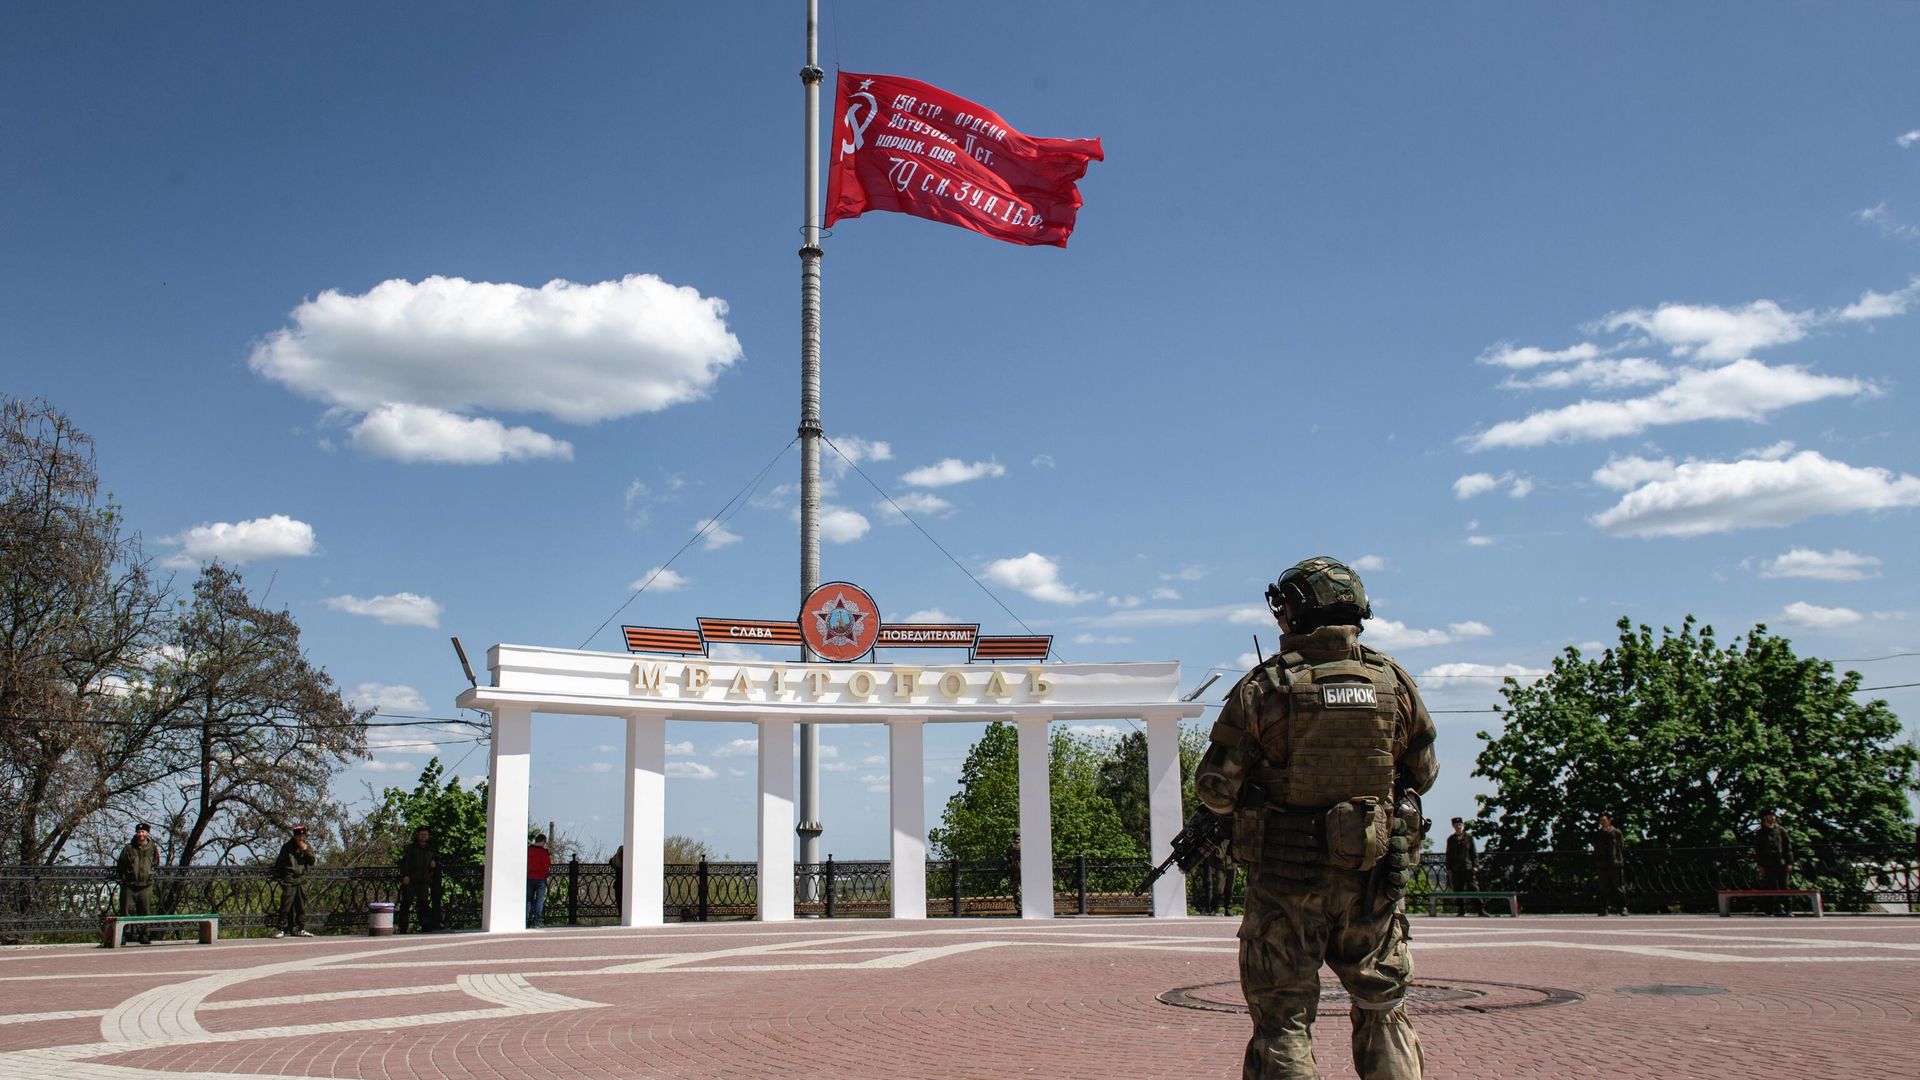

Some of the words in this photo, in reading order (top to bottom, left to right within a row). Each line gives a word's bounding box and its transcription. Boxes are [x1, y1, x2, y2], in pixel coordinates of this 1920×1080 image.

[892, 94, 917, 112] 150
[918, 102, 943, 121] СТР.
[955, 112, 1007, 141] ОРДЕНА
[888, 157, 919, 192] 79
[730, 625, 773, 638] СЛАВА
[882, 629, 971, 642] ПОБЕДИТЕЛЯМ!
[1326, 687, 1376, 704] БИРЮК
